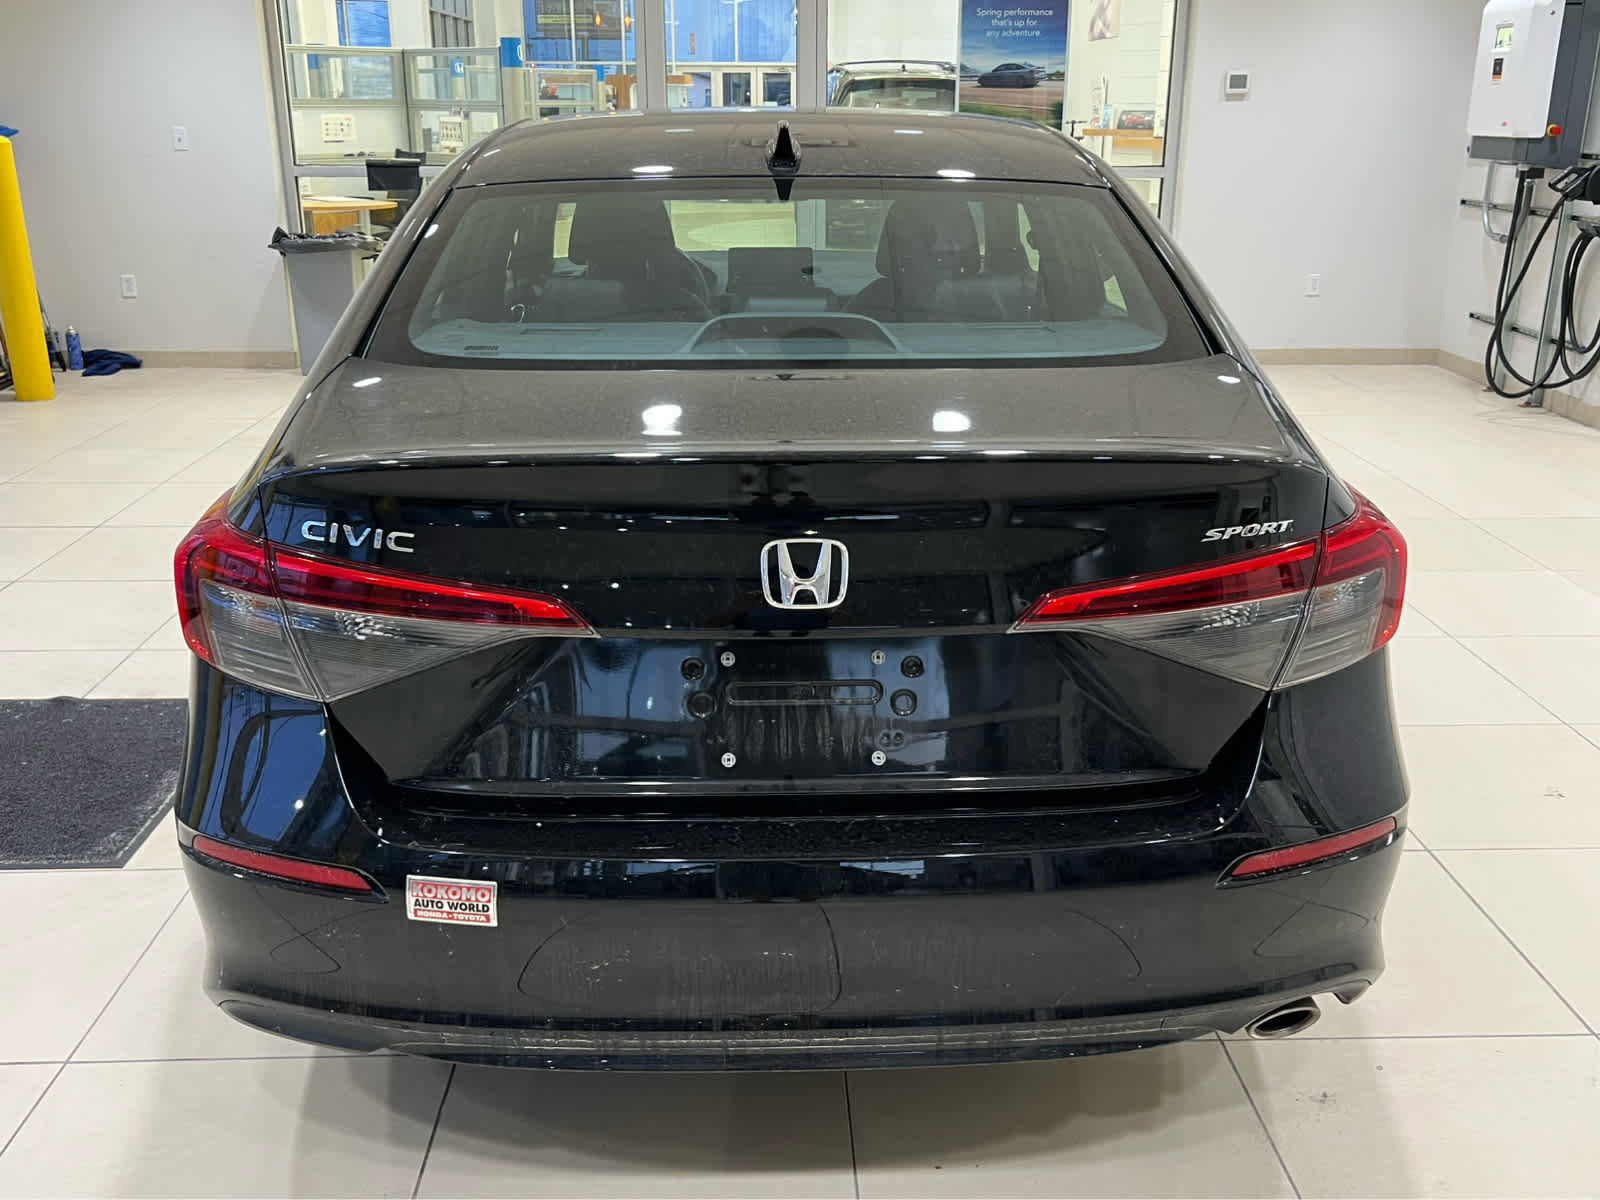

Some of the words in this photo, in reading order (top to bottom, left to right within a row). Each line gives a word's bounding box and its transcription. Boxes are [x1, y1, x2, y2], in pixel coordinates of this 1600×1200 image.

[976, 8, 1002, 18] Spring
[1003, 8, 1053, 17] performance
[991, 18, 1012, 26] that's
[1014, 19, 1025, 28] up
[1026, 17, 1038, 26] for
[986, 30, 1000, 38] any
[1001, 29, 1040, 37] adventure
[301, 520, 415, 553] CIVIC
[1200, 519, 1295, 543] SPORT
[411, 882, 490, 902] KOKOMO
[414, 898, 444, 909] AUTO
[447, 902, 490, 913] WORLD
[452, 913, 487, 922] TOYOTA
